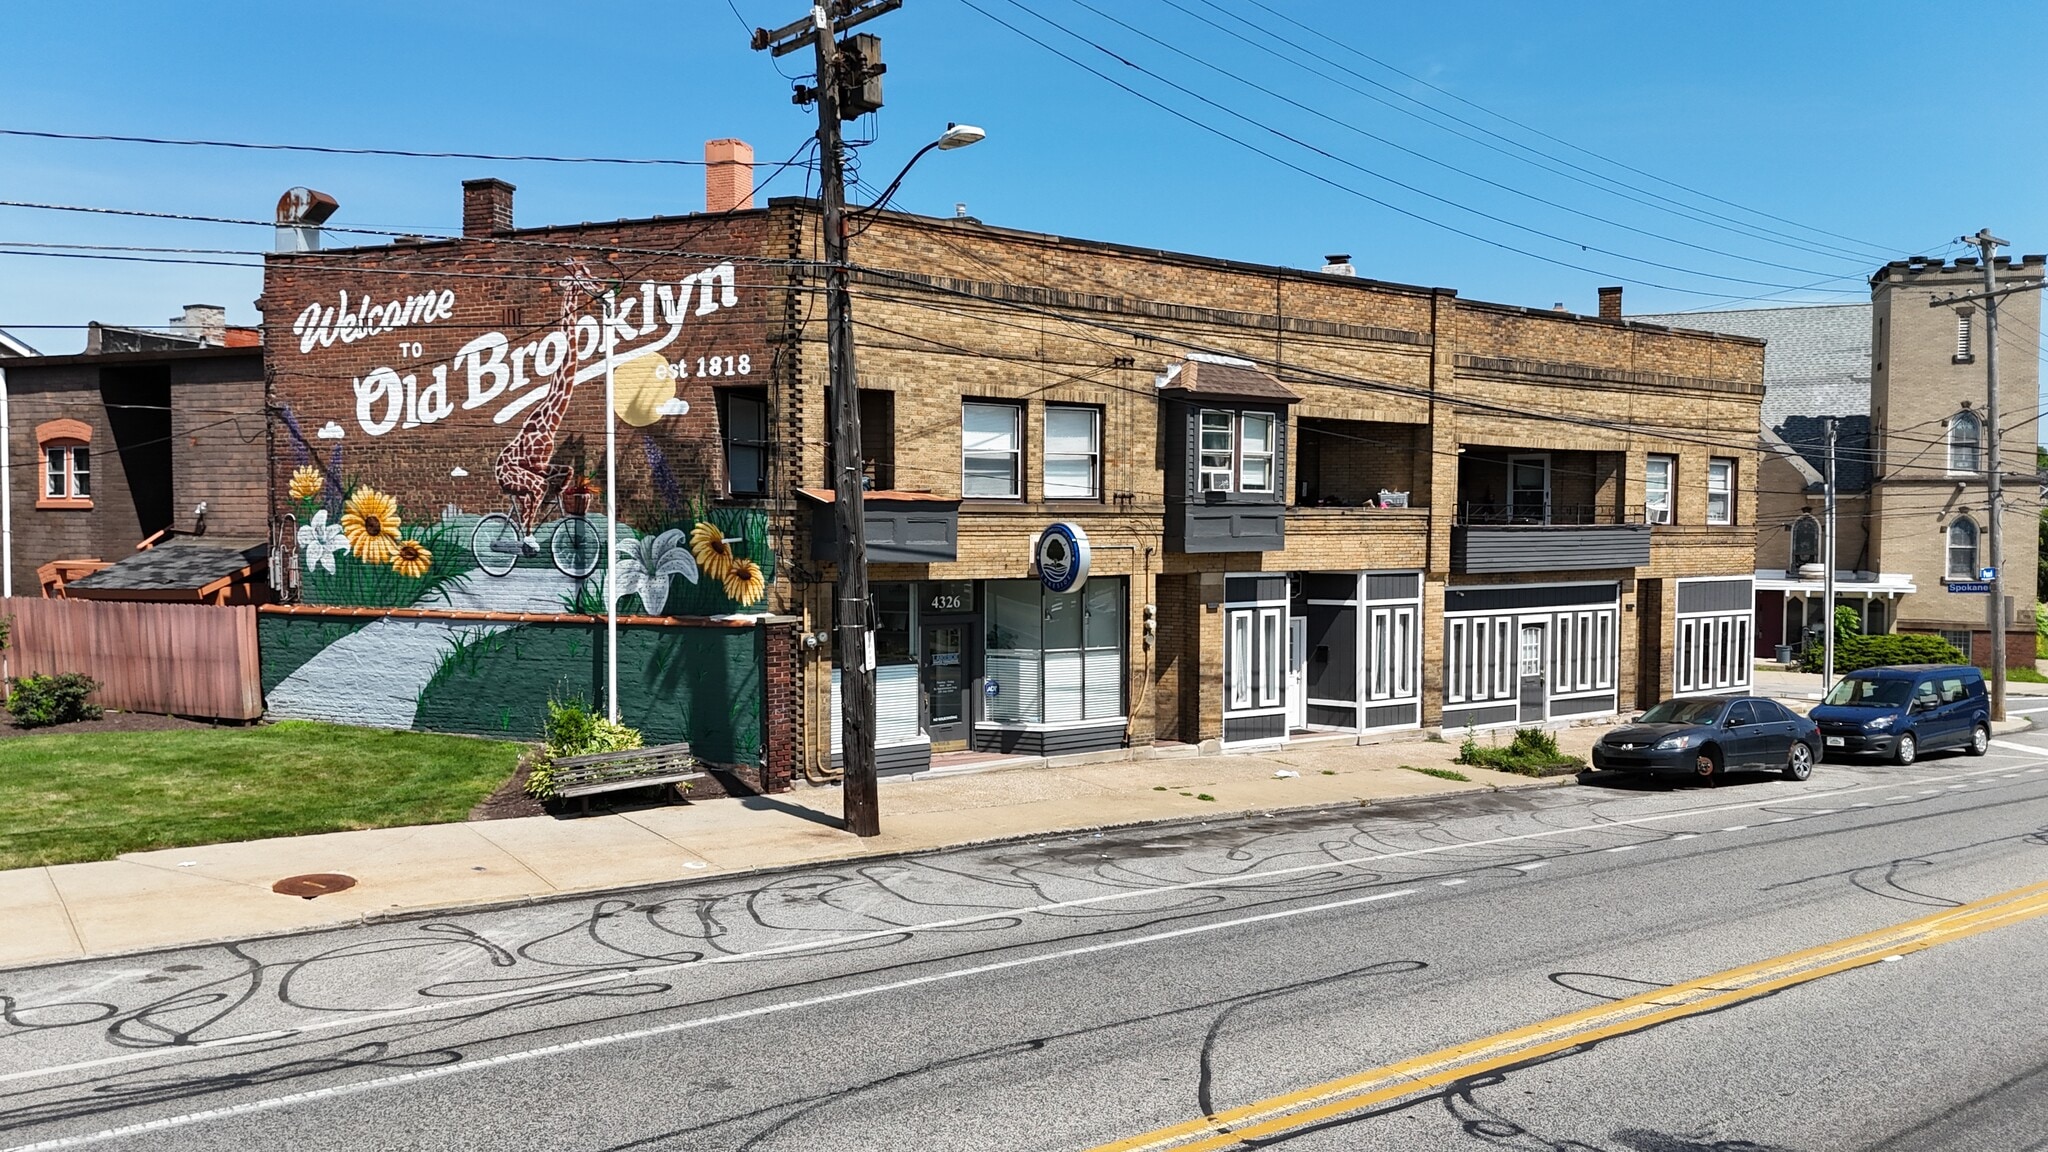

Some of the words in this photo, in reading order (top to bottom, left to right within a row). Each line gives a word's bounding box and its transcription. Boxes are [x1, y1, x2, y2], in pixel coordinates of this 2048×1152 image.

[293, 288, 455, 354] Welcome
[353, 365, 455, 437] Old
[454, 261, 739, 424] Brooklyn
[399, 341, 423, 359] TO
[655, 361, 688, 381] est
[697, 353, 752, 379] 1818
[1949, 584, 1989, 592] Spokane
[931, 595, 961, 609] 4326
